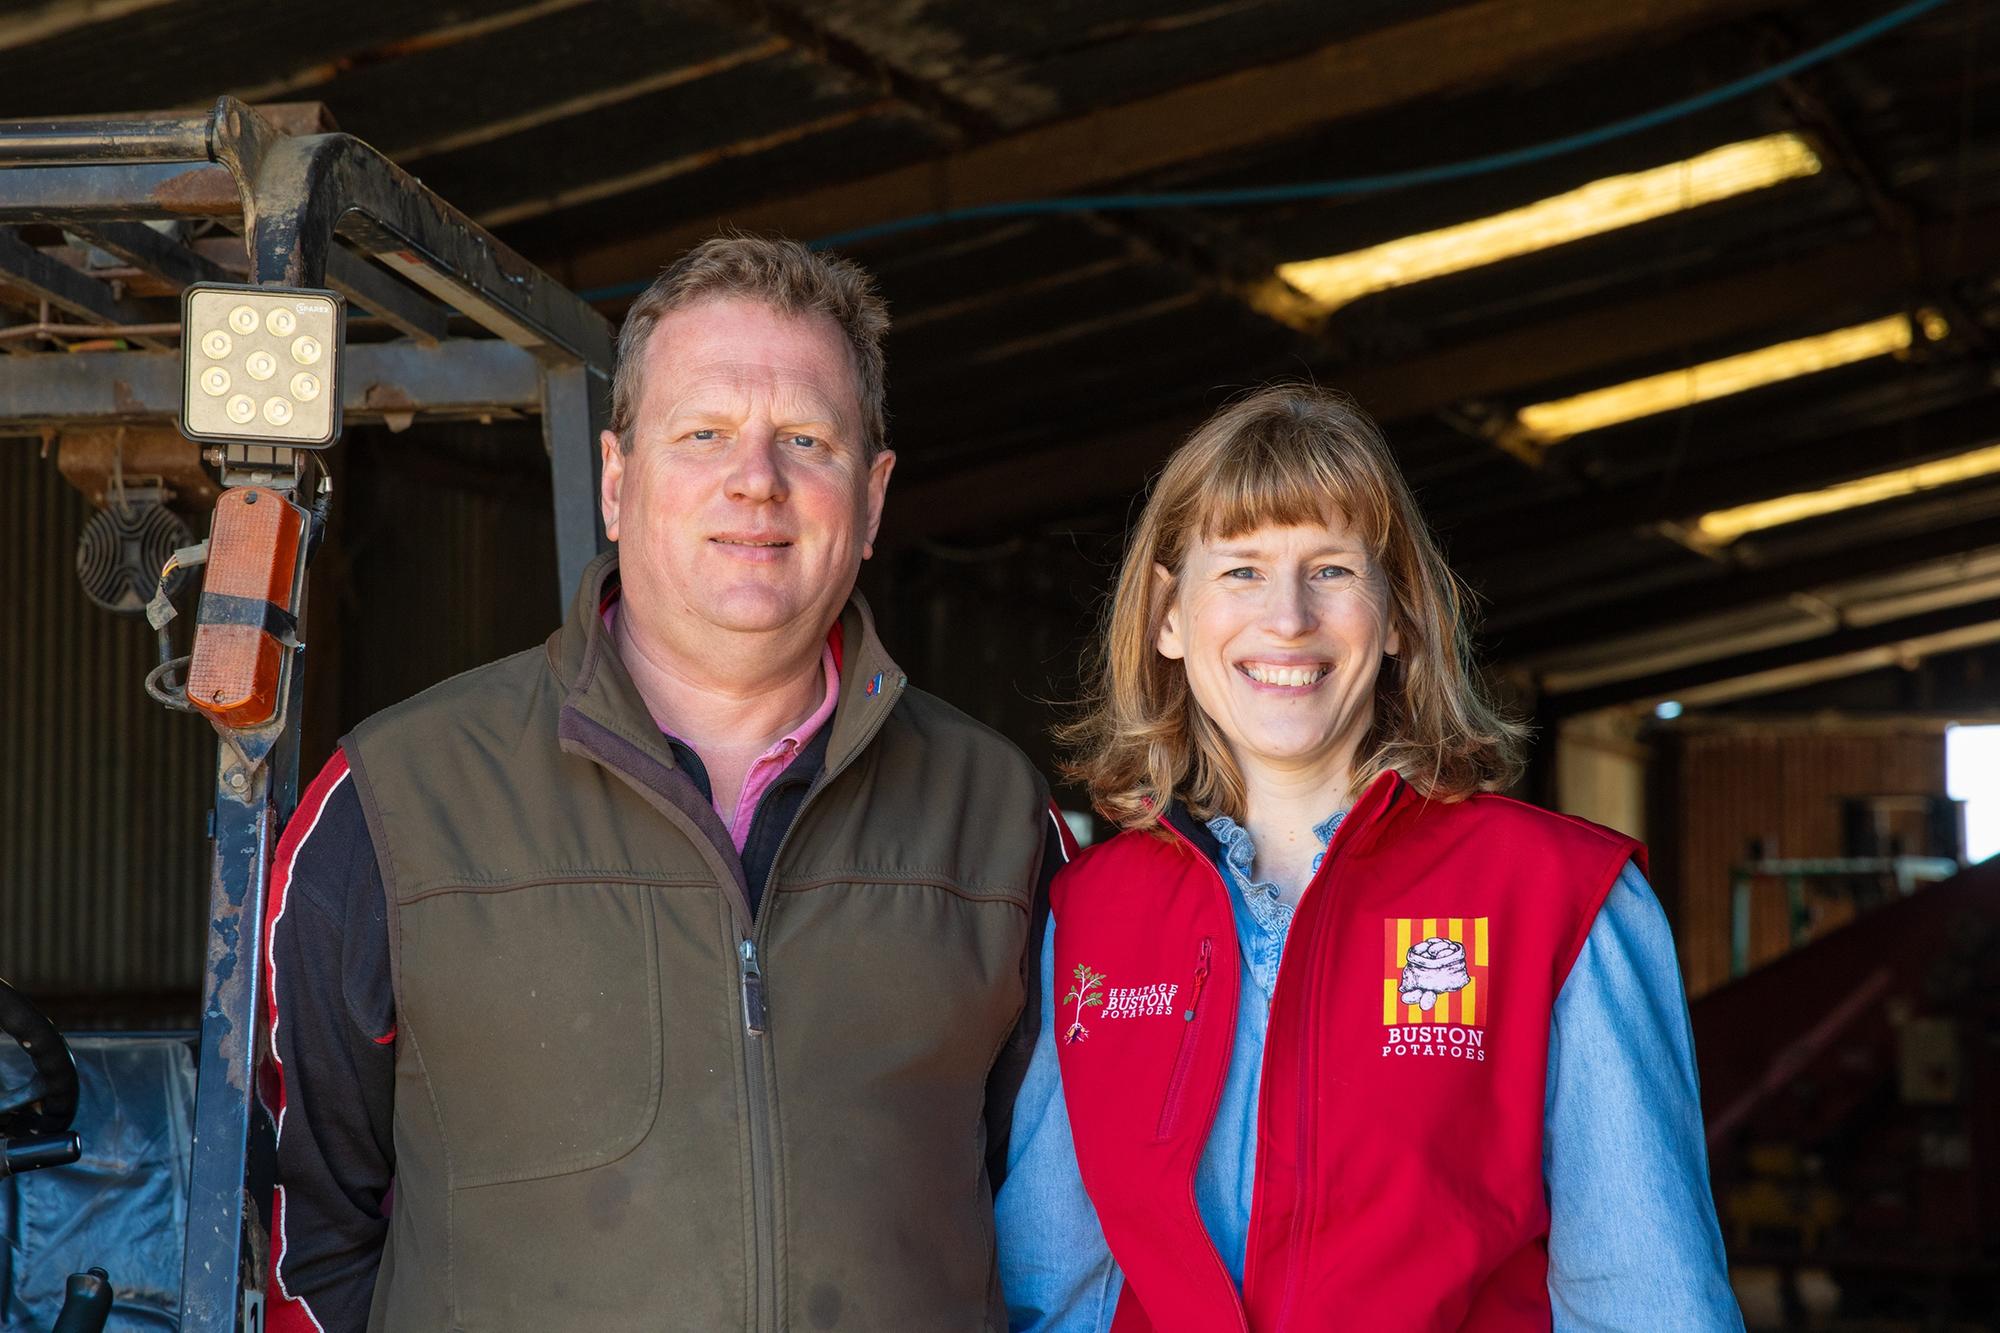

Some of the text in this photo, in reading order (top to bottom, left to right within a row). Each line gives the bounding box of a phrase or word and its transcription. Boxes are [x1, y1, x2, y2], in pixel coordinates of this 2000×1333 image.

[1108, 983, 1179, 997] HERITAGE
[1106, 992, 1175, 1011] BUSTON
[1100, 1006, 1173, 1019] POTATOES
[1388, 1026, 1484, 1047] BUSTON
[1382, 1044, 1485, 1062] POTATOES
